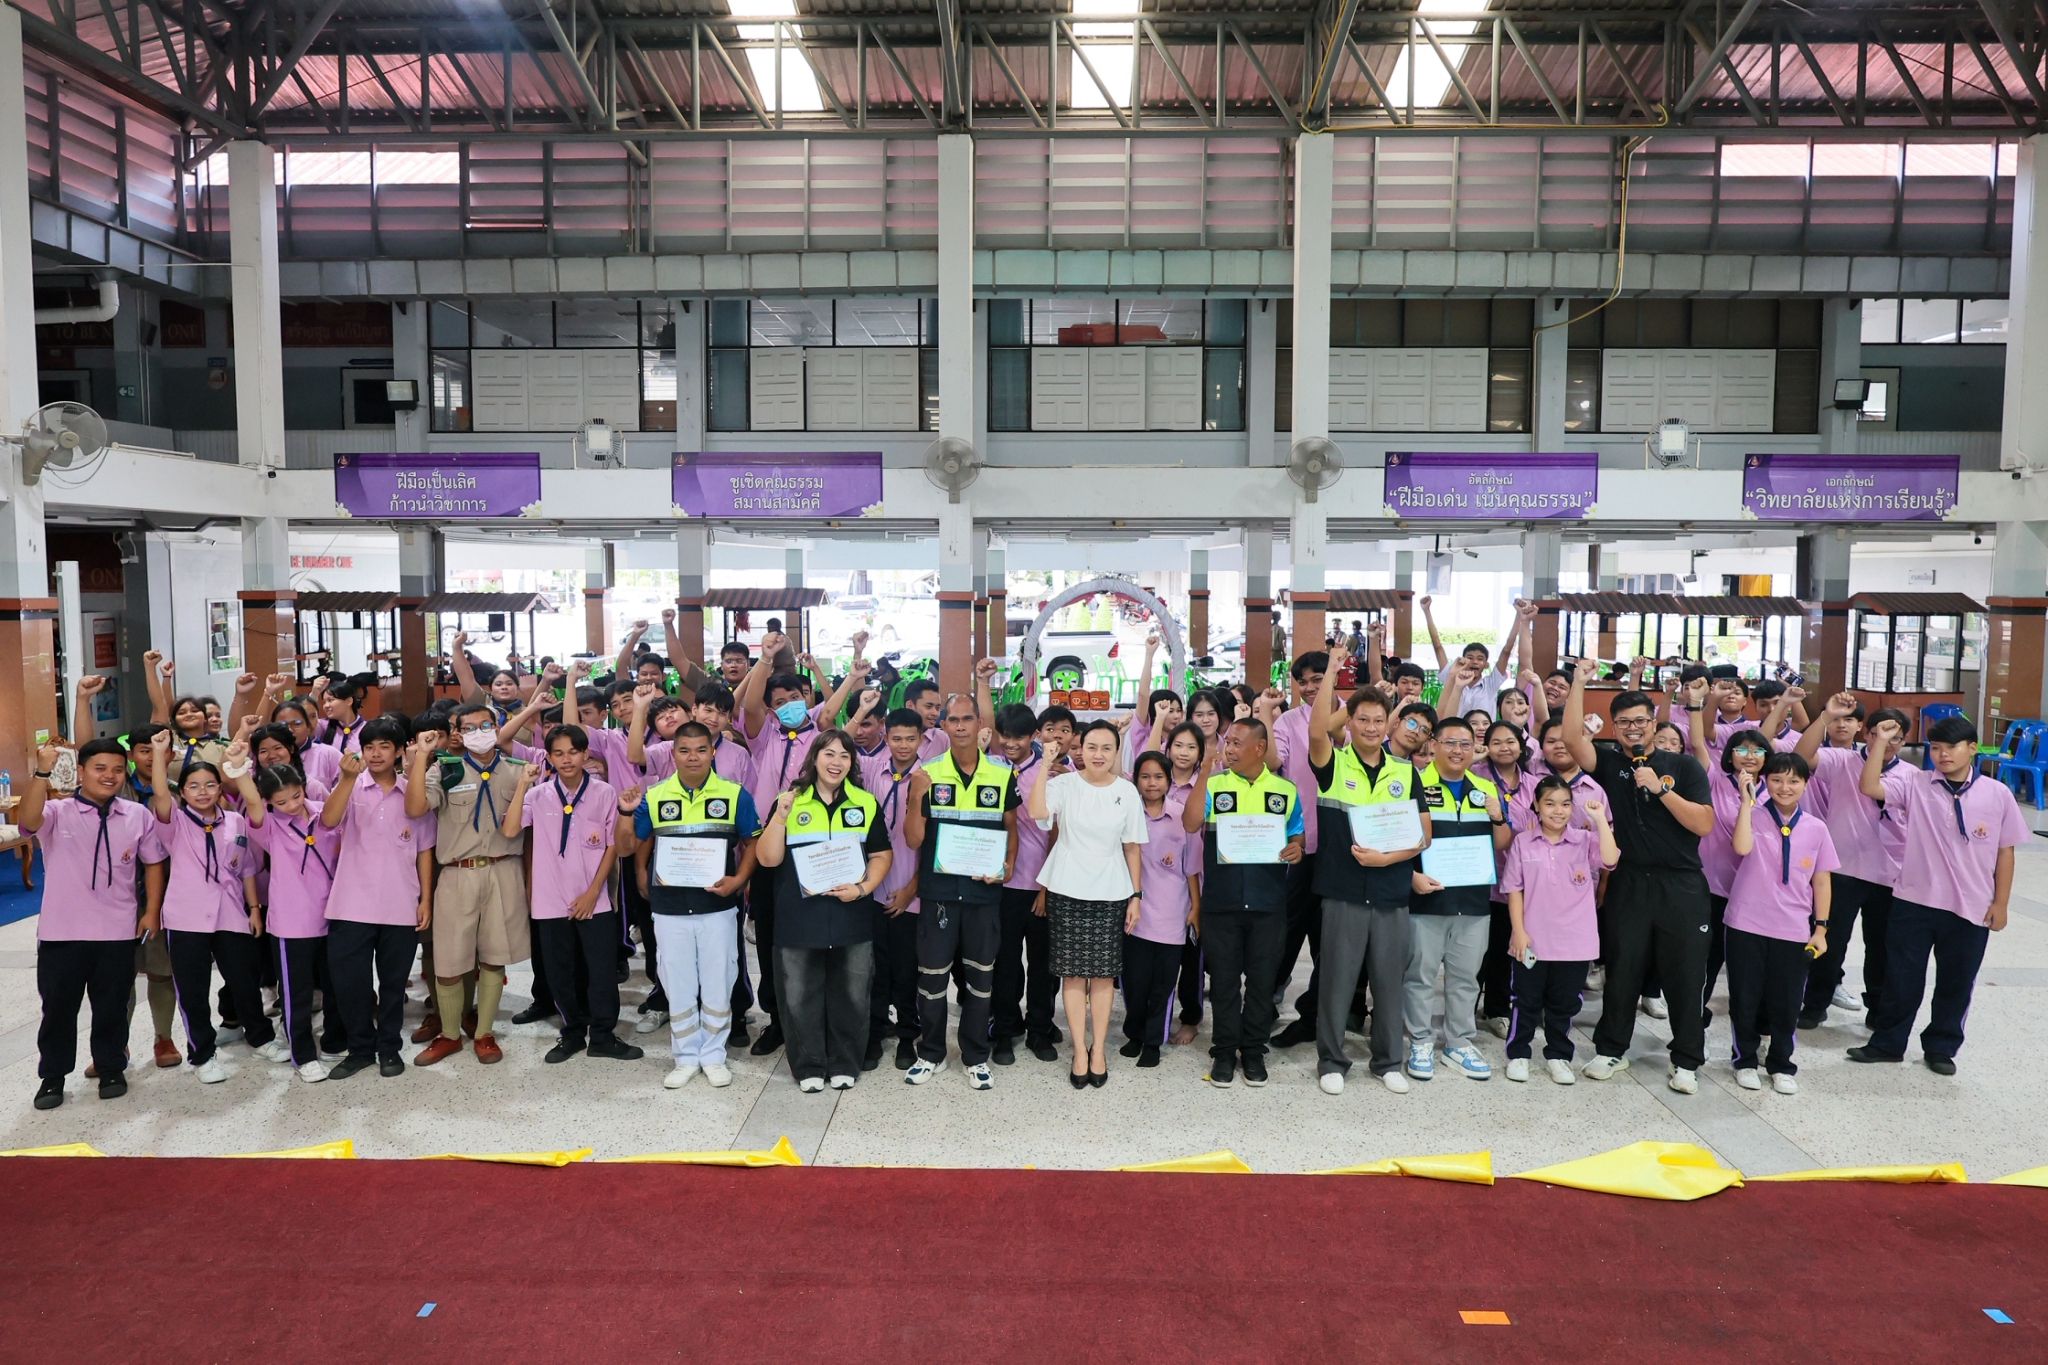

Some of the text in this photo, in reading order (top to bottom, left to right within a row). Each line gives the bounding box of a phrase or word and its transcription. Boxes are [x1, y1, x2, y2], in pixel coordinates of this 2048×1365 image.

[168, 324, 198, 338] ONE
[396, 471, 476, 489] ฝีมือเป็นเลิศ
[730, 471, 823, 494] ชูเชิดคุณธรรม
[1468, 473, 1514, 485] อัตลักษณ์
[1826, 474, 1875, 487] เอกลักษณ์
[389, 494, 487, 512] ก้าวนำวิชาการ
[733, 492, 820, 510] สมานสามัคคี
[290, 555, 353, 568] BE NUMBER ONE
